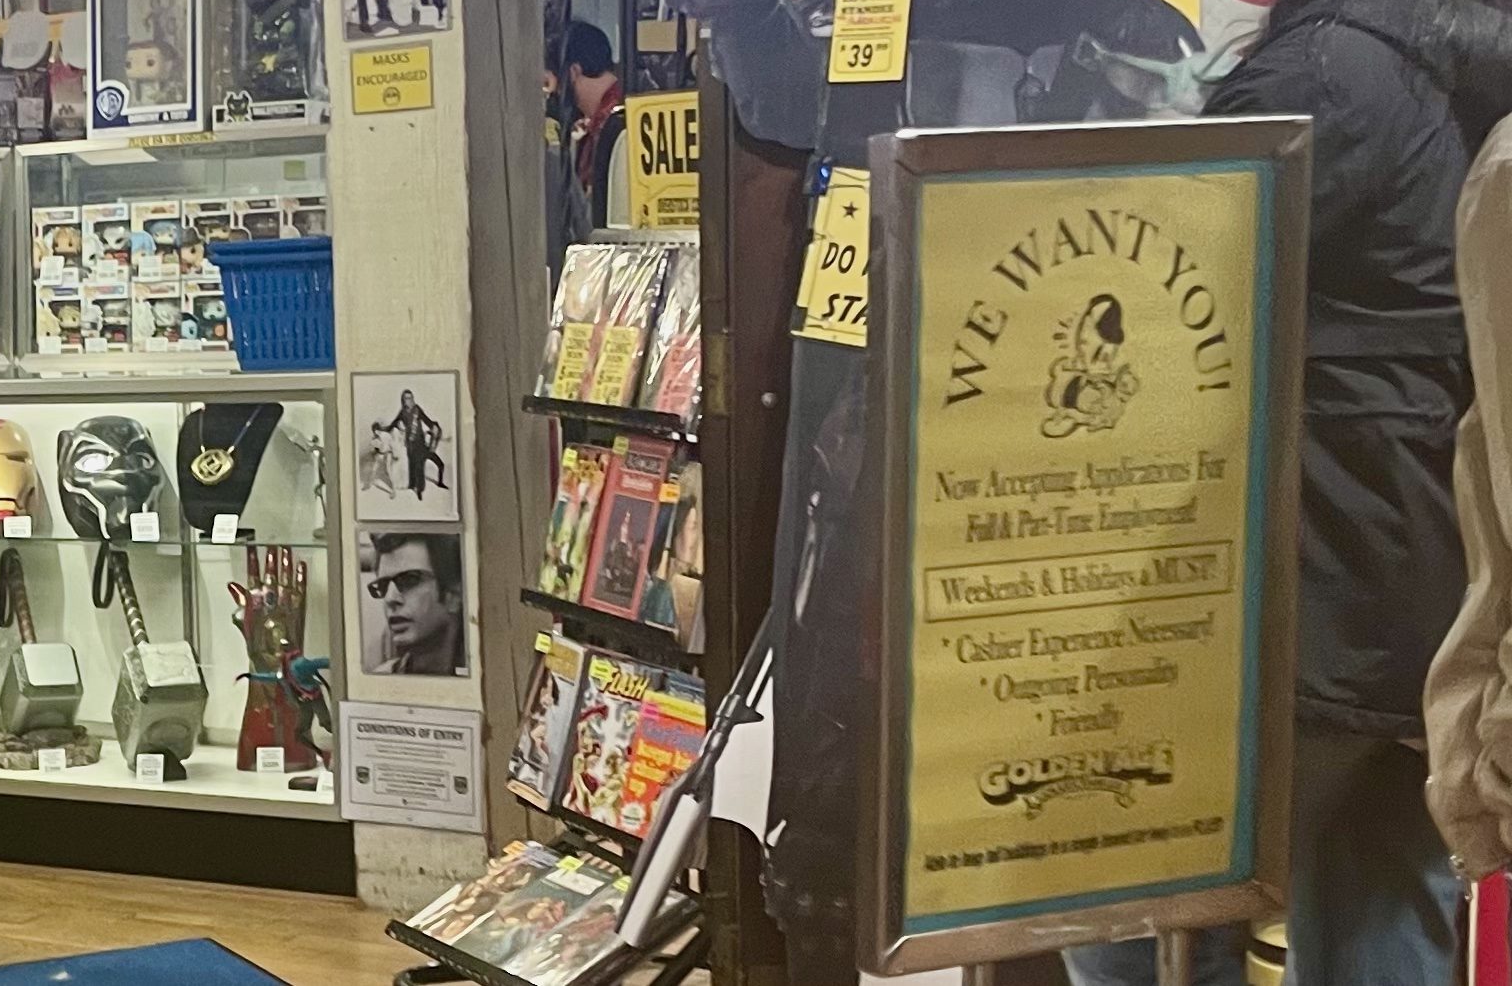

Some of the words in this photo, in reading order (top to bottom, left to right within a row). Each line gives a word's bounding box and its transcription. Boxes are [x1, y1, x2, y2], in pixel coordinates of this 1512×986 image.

[372, 53, 410, 65] MASKS
[847, 43, 874, 68] 39
[356, 69, 428, 86] ENCOURAGED
[640, 109, 700, 176] SALE
[820, 241, 857, 275] DO
[942, 299, 1009, 409] WE
[991, 208, 1160, 293] WANT
[1162, 241, 1233, 394] YOU!
[356, 722, 417, 738] CONDITIONS
[418, 727, 431, 739] OF
[433, 729, 465, 741] ENTRY
[979, 750, 1102, 806] GOLDEN
